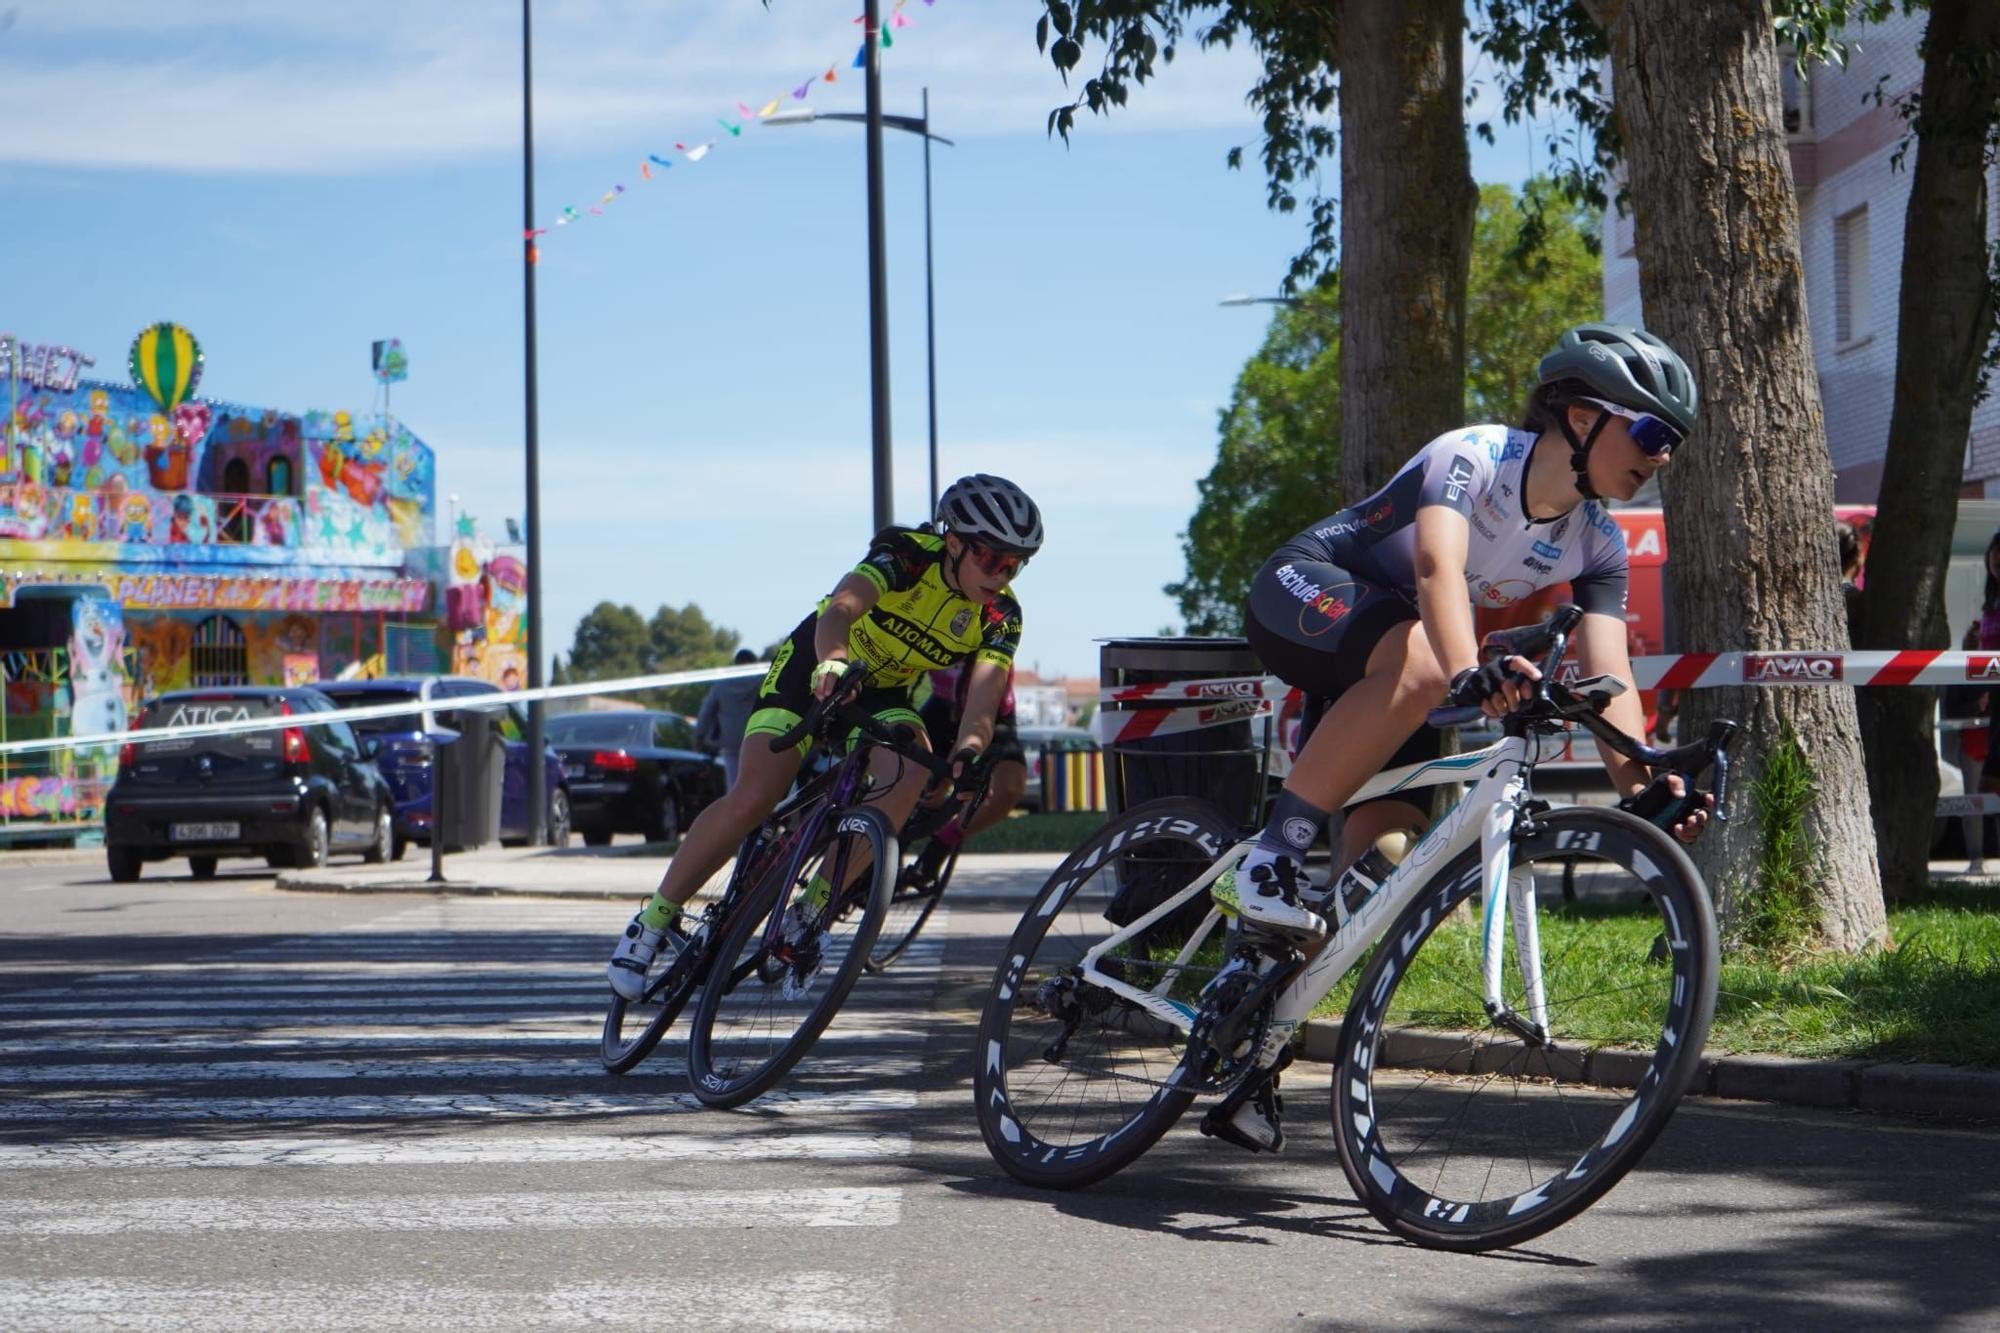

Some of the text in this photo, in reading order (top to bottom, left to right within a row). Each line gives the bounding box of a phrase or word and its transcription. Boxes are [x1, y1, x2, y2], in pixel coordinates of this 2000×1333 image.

[1445, 463, 1472, 502] EKT
[1275, 564, 1353, 620] enchufesolar
[167, 704, 251, 727] ÁTICA
